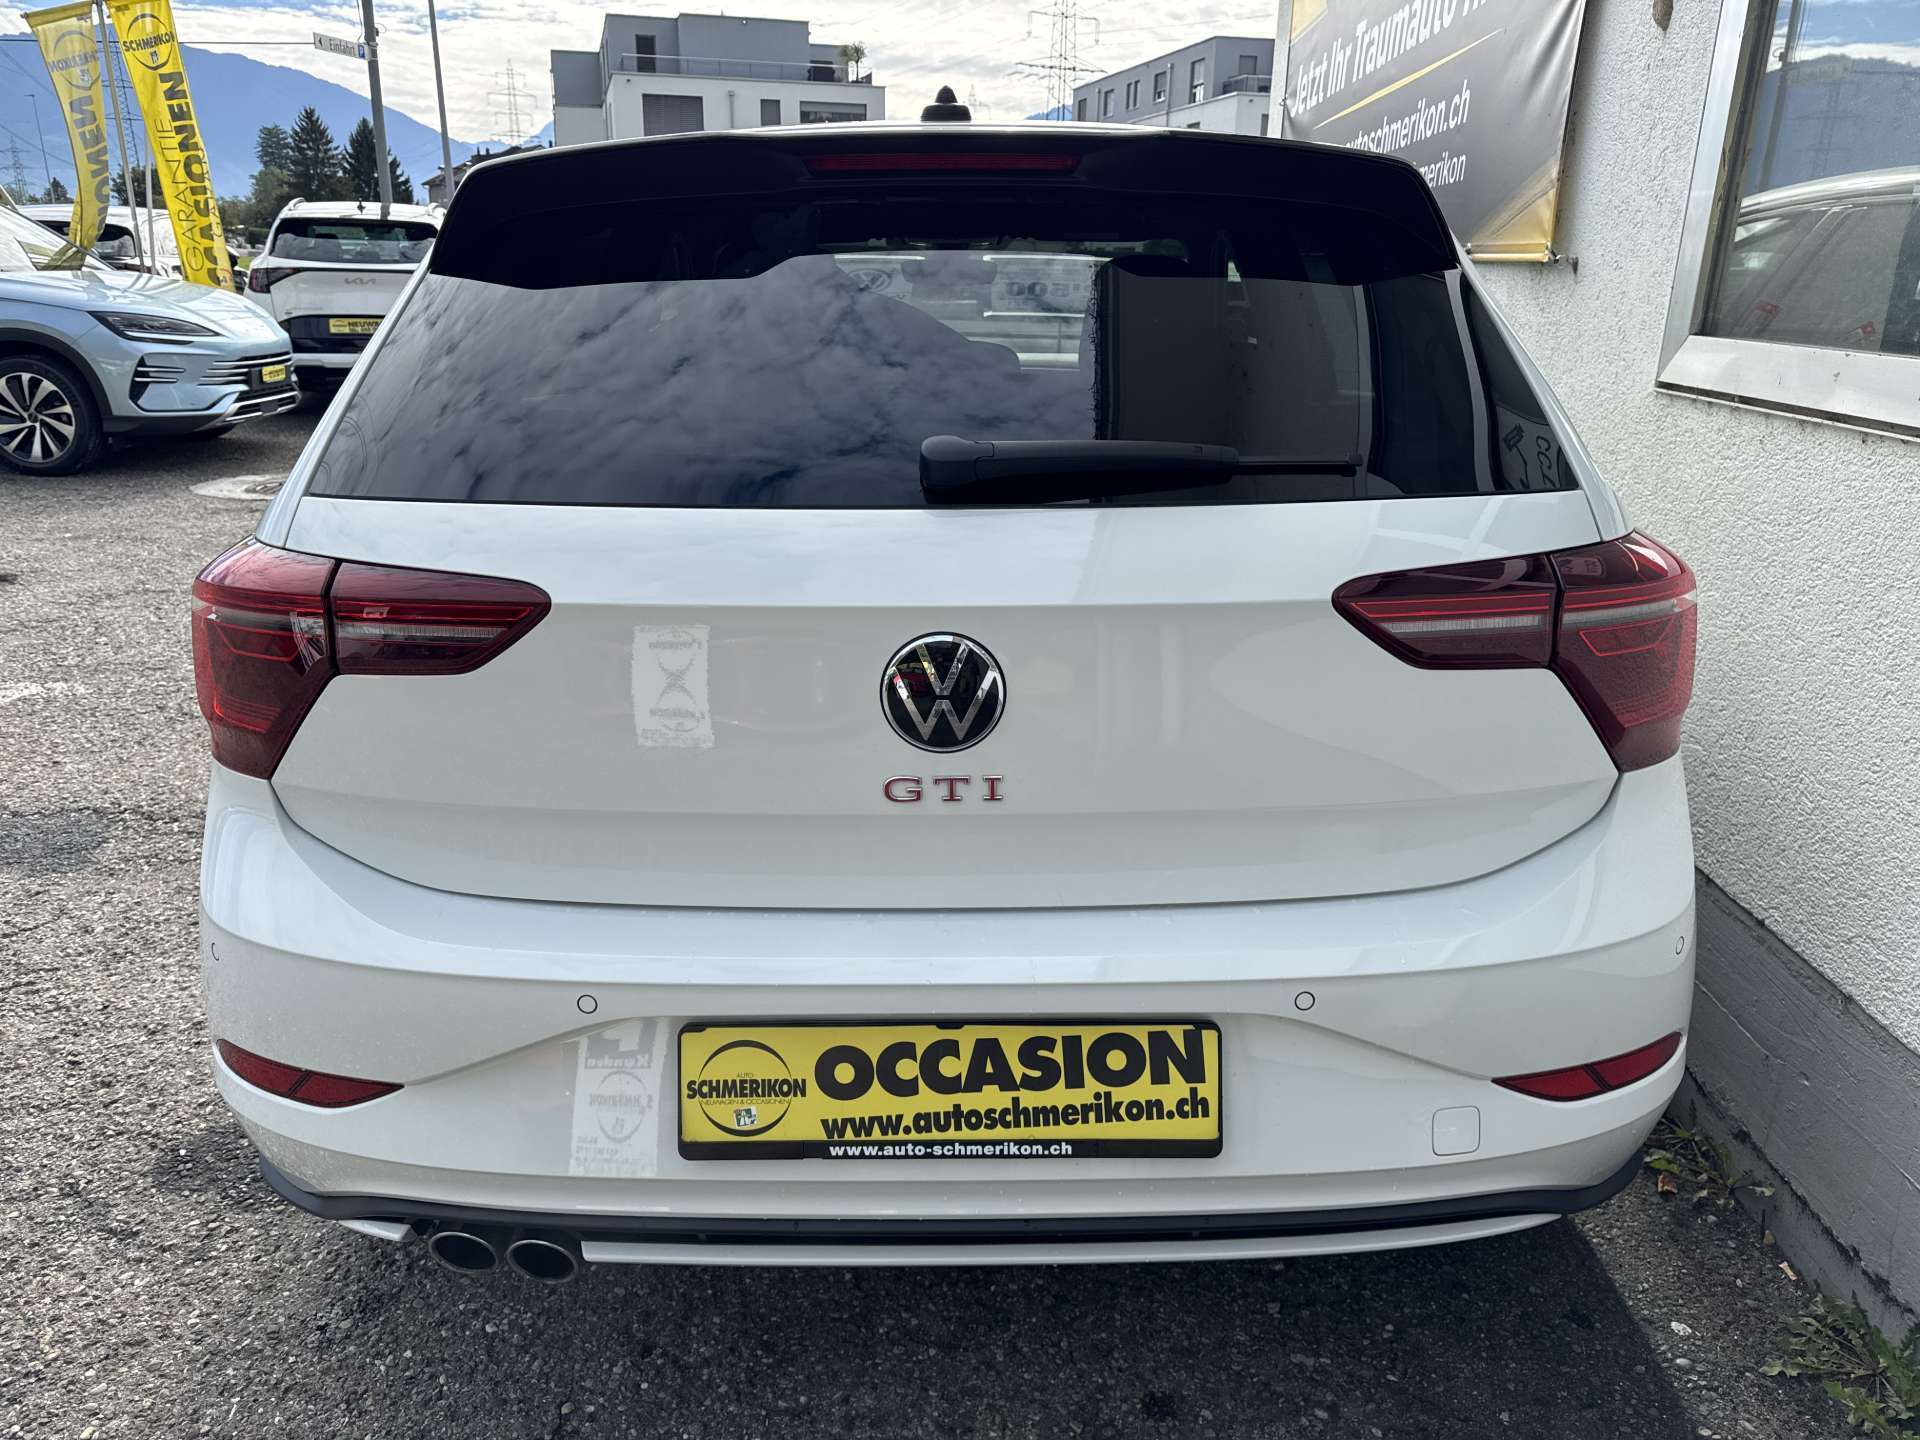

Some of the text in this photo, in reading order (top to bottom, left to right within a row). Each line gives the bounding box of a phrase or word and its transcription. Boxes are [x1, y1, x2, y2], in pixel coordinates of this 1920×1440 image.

[1290, 0, 1457, 118] Jetzt Ihr Traumauto
[1345, 79, 1471, 154] toschmerikon.ch
[154, 118, 205, 272] GARANTIE
[1414, 151, 1467, 188] merikon
[883, 774, 1004, 803] GTI
[686, 1078, 807, 1099] SCHMERIKON
[814, 1028, 1207, 1101] OCCASION
[820, 1087, 1211, 1140] www.autoschmerikon.ch
[829, 1142, 1073, 1156] www.auto-schmerikon.ch
